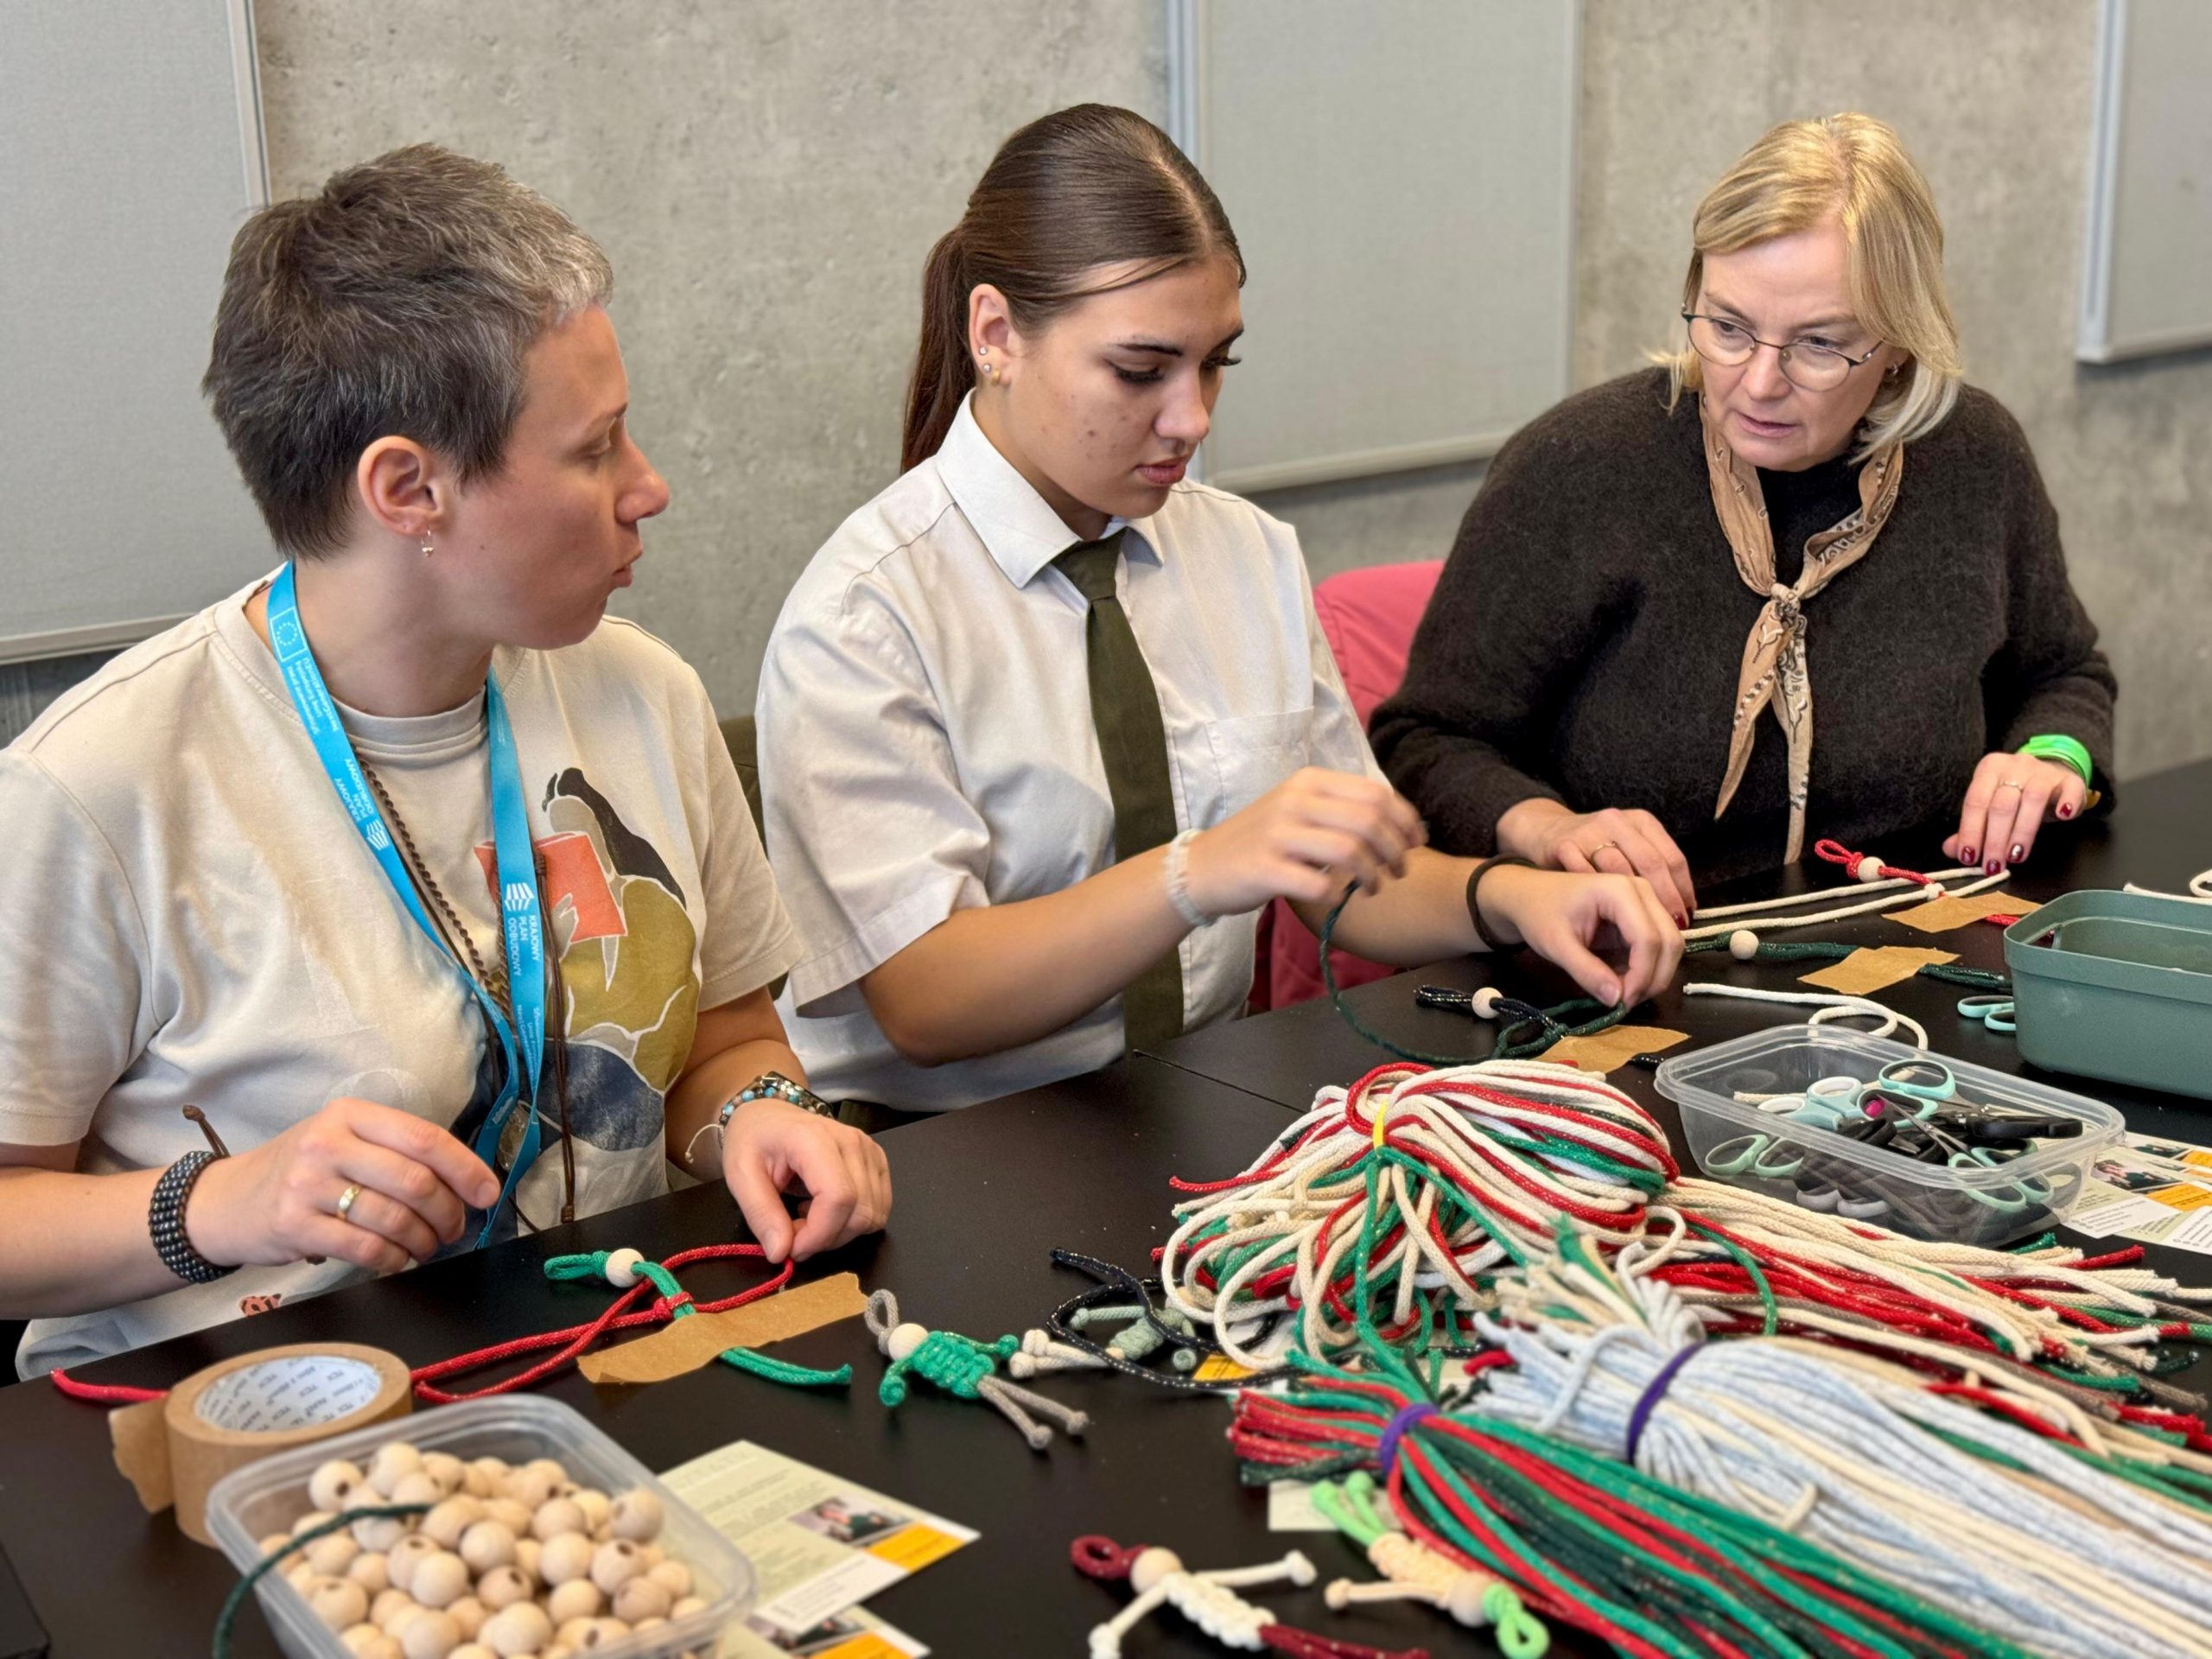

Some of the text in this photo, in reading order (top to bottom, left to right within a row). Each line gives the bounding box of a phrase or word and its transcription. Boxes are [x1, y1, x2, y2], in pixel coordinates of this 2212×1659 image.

[335, 778, 361, 822] KRAJOWY
[345, 759, 374, 814] ODBUDOWY
[353, 794, 367, 817] PLAN
[508, 918, 522, 976] ODBUDOWY
[518, 916, 528, 941] PLAN
[529, 915, 540, 961] KRAJOWY
